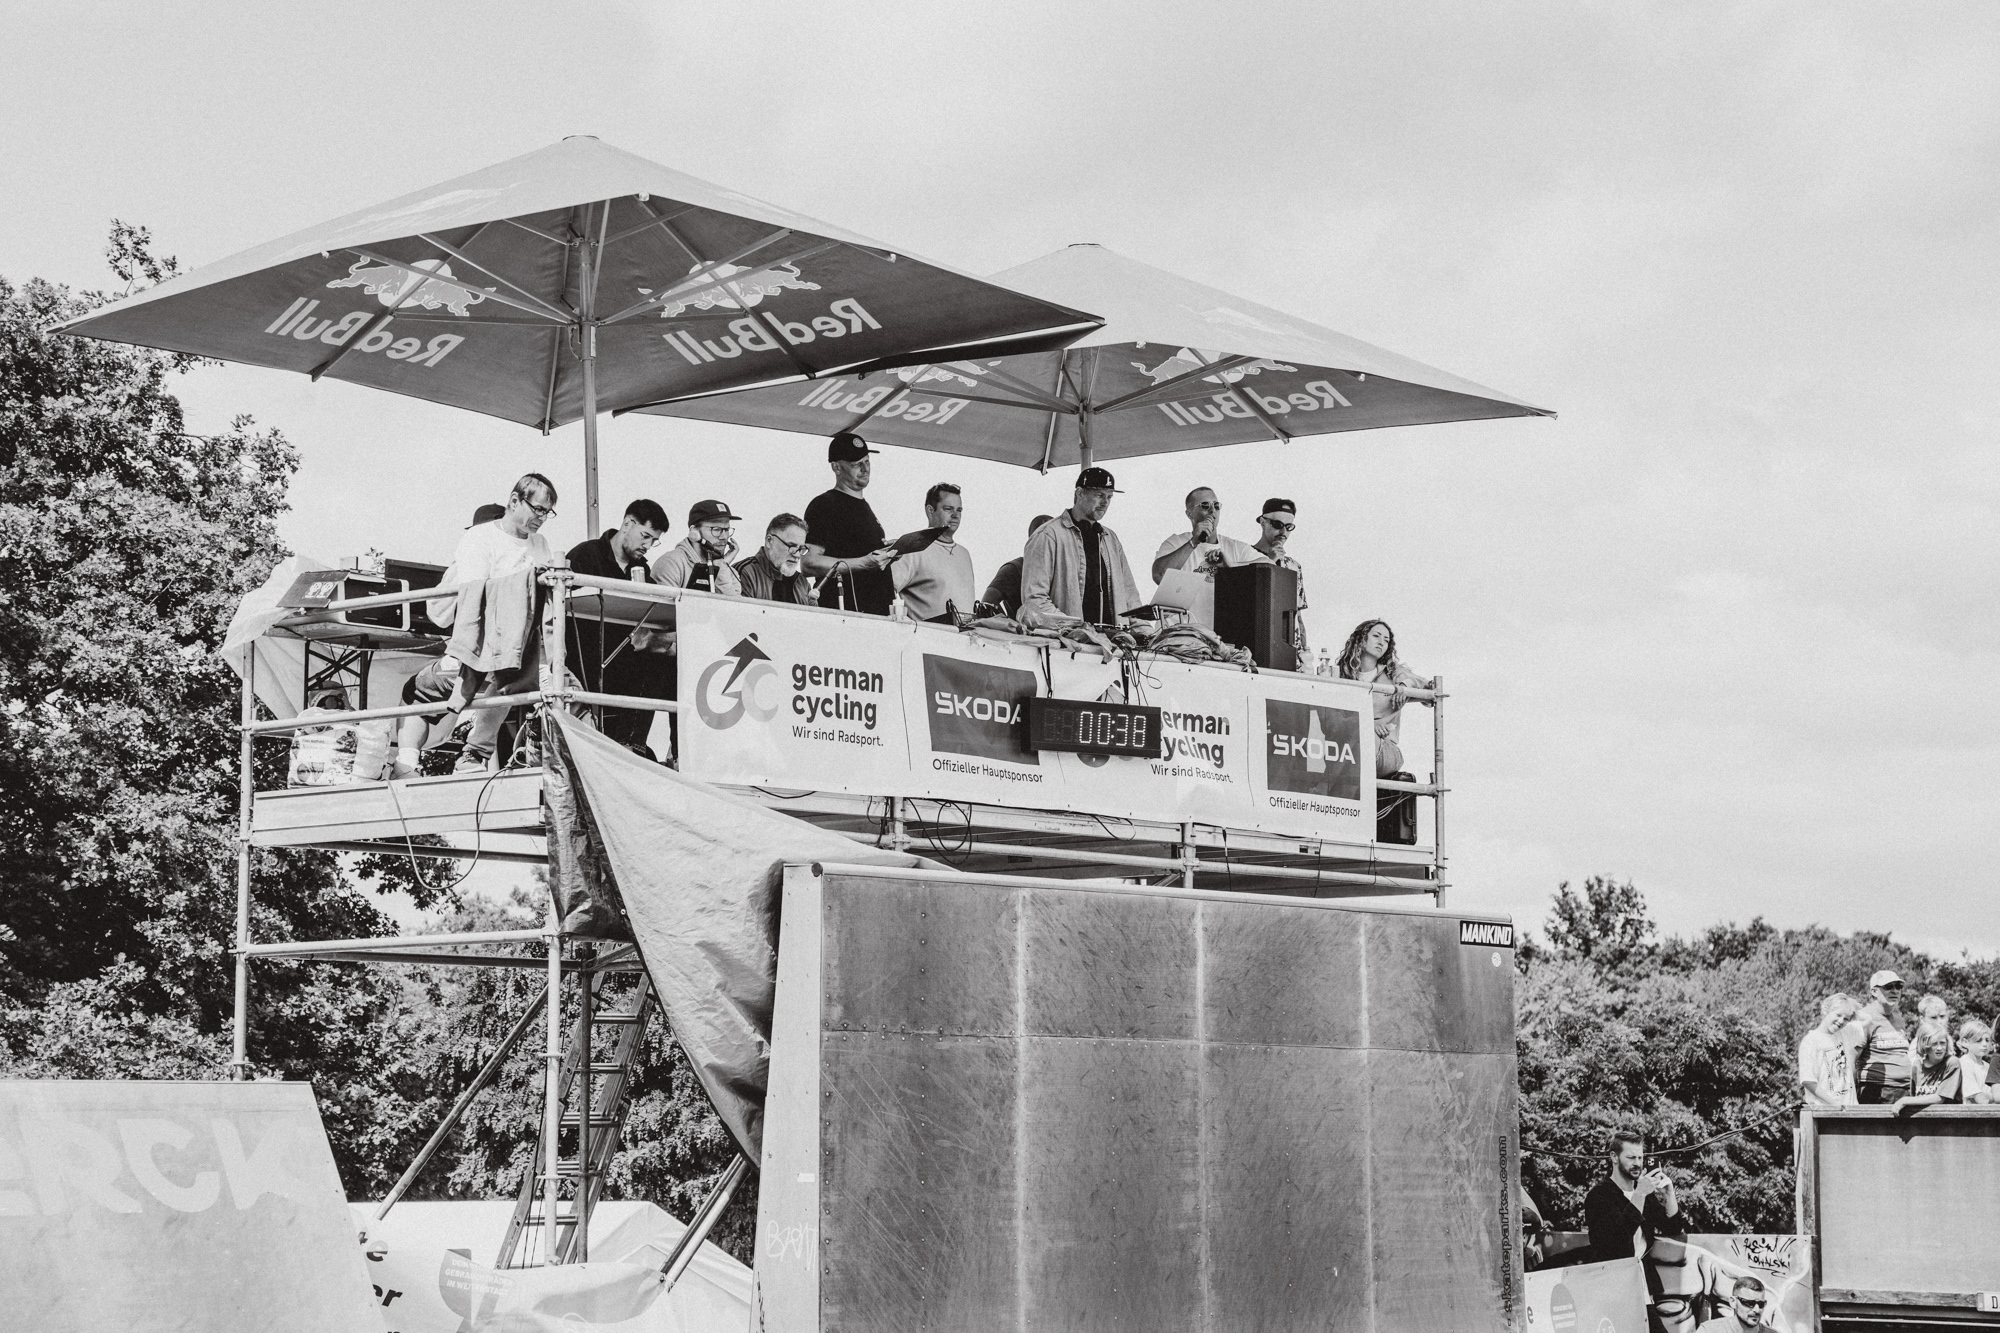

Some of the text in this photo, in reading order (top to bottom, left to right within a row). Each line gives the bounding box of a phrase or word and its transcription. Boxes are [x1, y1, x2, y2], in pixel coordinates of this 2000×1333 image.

[791, 662, 884, 694] german
[792, 692, 877, 730] cycling
[1160, 710, 1231, 736] erman
[792, 725, 885, 747] Wir sind Radsport.
[1078, 711, 1147, 748] 00:38
[1160, 735, 1225, 769] ycling
[932, 758, 1043, 783] Offizieller Hauptsponsor
[1151, 763, 1169, 776] Wir
[1171, 765, 1194, 778] sind
[1269, 796, 1361, 818] Offizieller Hauptsponsor
[1461, 923, 1513, 946] MANKIND
